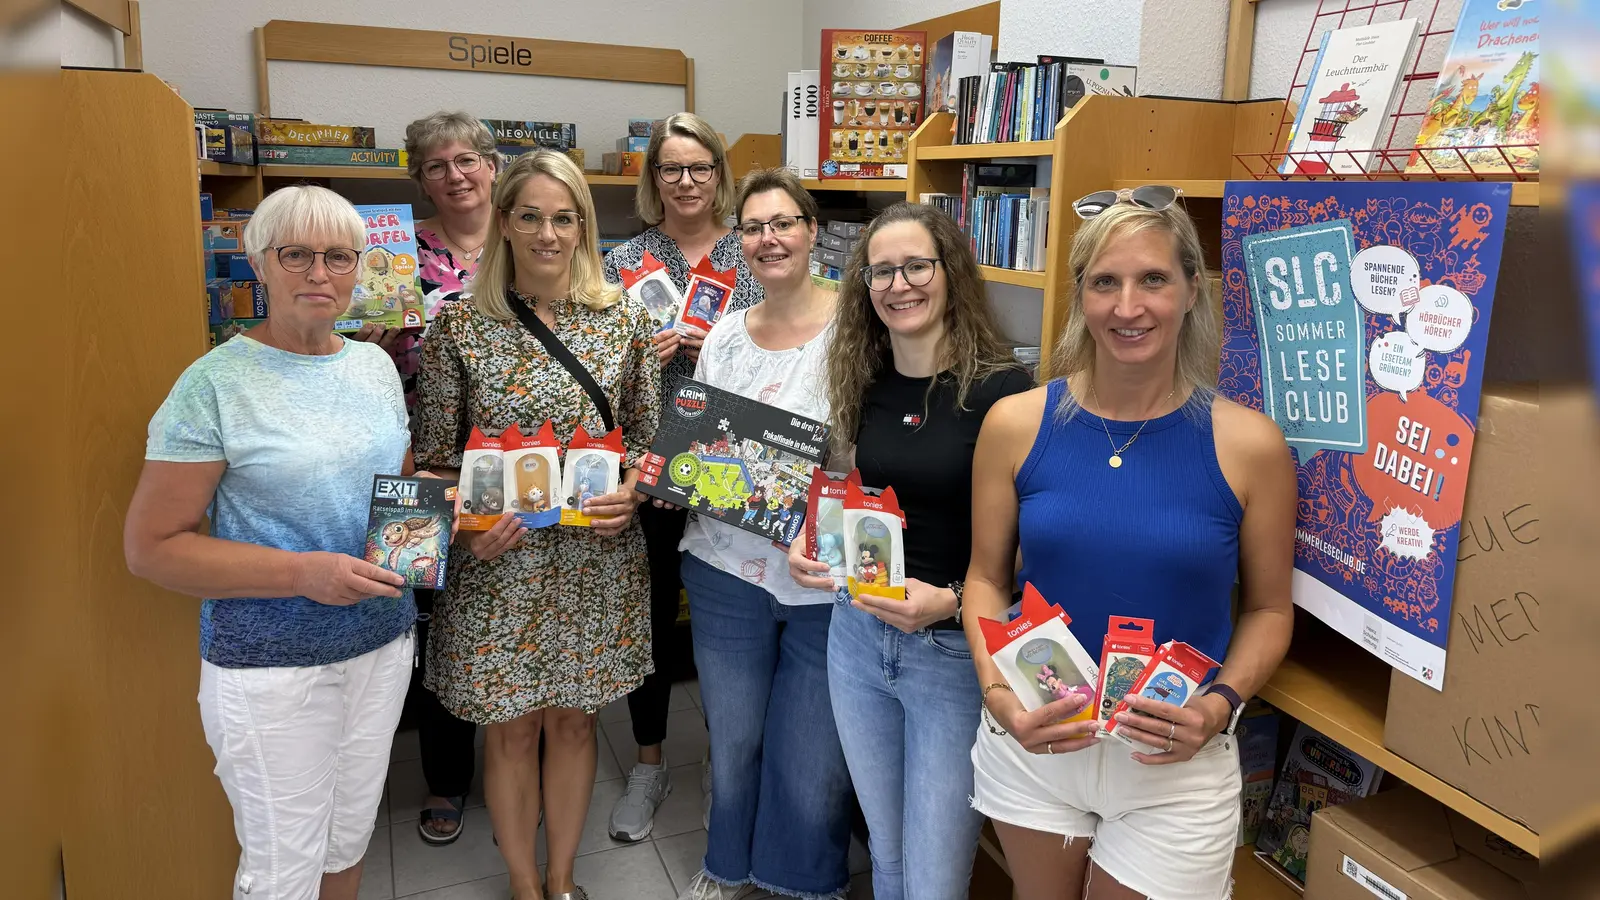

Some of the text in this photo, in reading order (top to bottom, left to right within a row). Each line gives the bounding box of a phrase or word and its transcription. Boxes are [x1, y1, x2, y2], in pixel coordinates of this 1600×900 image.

[1480, 15, 1539, 32] Wer will noc
[864, 33, 892, 42] COFFEE
[448, 36, 532, 69] Spiele
[1352, 55, 1368, 64] Der
[1325, 63, 1389, 78] Leuchtturmbär
[806, 84, 818, 119] 1000
[288, 129, 350, 143] DECIPHER
[497, 129, 560, 140] NEOVILLE
[350, 151, 396, 164] ACTIVITY
[401, 257, 407, 265] 3
[1363, 262, 1406, 275] SPANNENDE
[1264, 251, 1342, 311] SLC
[1370, 272, 1398, 286] BÜCHER
[1371, 284, 1396, 297] LESEN?
[256, 283, 265, 317] KOSMOS
[1419, 311, 1462, 328] HÖRBÜCHER
[1276, 320, 1346, 342] SOMMER
[1424, 324, 1453, 340] HÖREN?
[1392, 343, 1404, 354] EIN
[1280, 348, 1347, 382] LESE
[1381, 352, 1412, 366] LESETEAM
[1378, 362, 1412, 378] GRÜNDEN?
[679, 388, 707, 401] KRIMI
[675, 396, 707, 411] PUZZLE
[1285, 390, 1349, 424] CLUB
[790, 417, 801, 427] Die
[801, 420, 815, 433] drei
[762, 429, 820, 455] Pokalfinale in Gefahr
[1395, 415, 1431, 455] SEI
[1373, 442, 1445, 501] DABEI!
[377, 480, 416, 498] EXIT
[397, 498, 420, 506] KIDS
[863, 500, 883, 510] tonies
[372, 505, 429, 515] Rätselspaß im Meer
[786, 514, 801, 543] KOSMOS
[1398, 526, 1420, 538] WERDE
[1396, 536, 1423, 549] KREATIV!
[437, 560, 446, 587] KOSMOS
[1006, 619, 1033, 639] tonies
[1171, 657, 1185, 668] tonies
